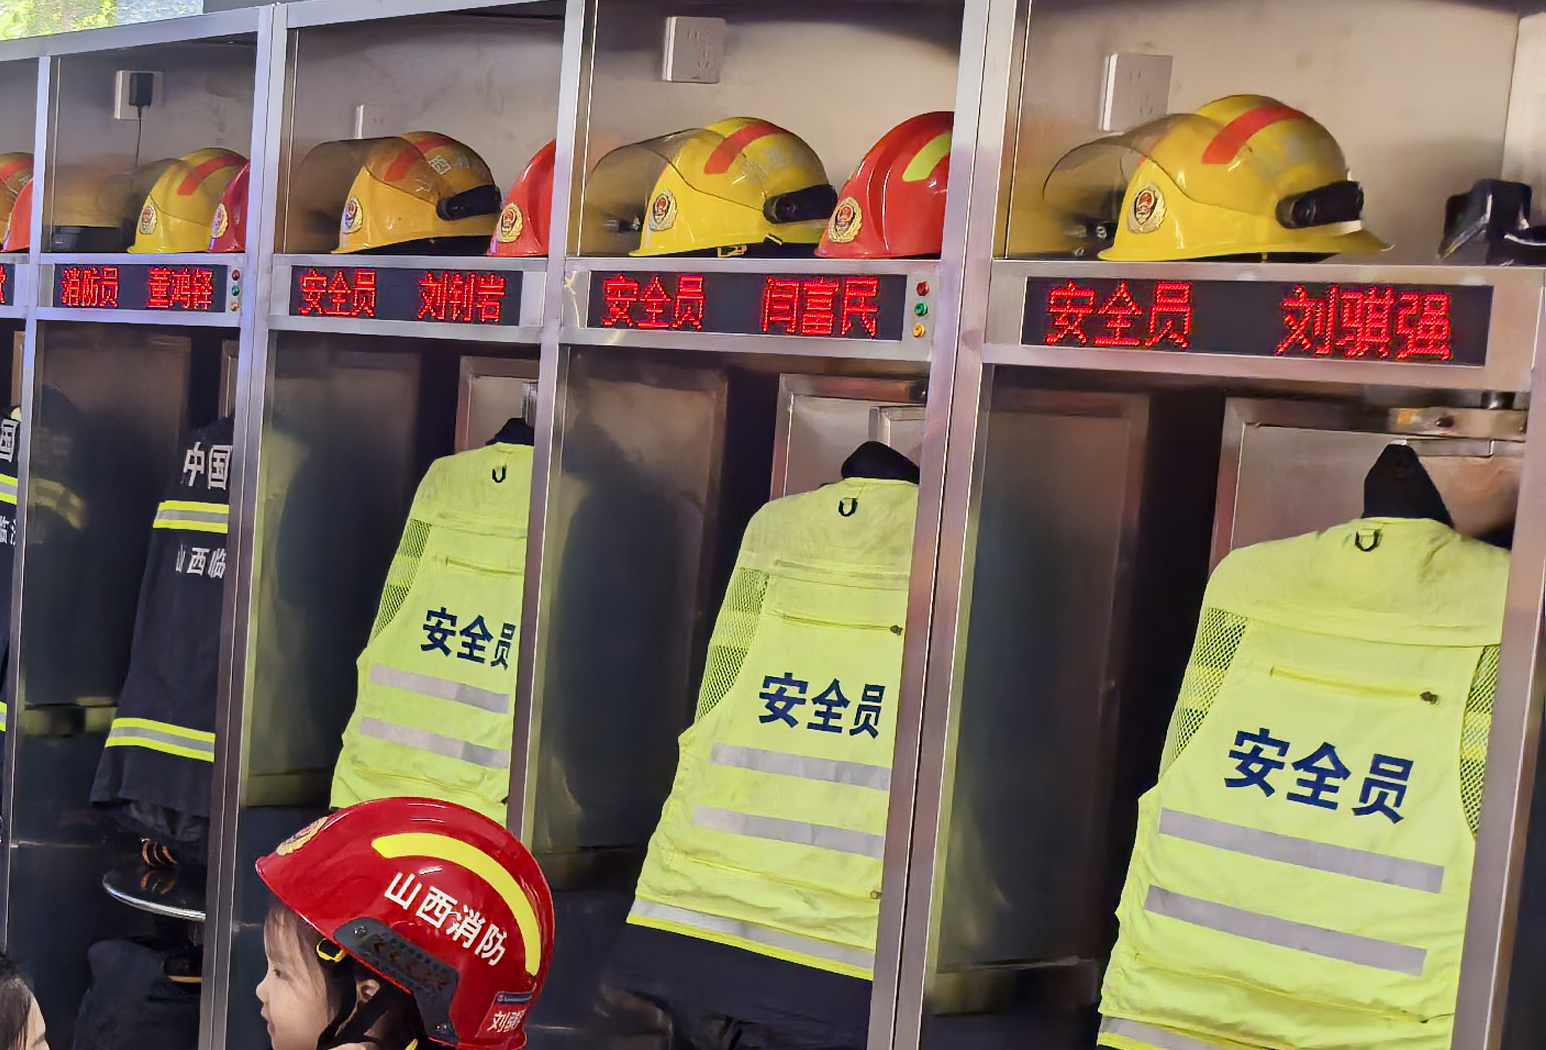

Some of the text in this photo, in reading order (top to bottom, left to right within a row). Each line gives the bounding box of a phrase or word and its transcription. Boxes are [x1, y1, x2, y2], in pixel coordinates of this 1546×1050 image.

[60, 267, 120, 309] 消防员
[299, 268, 377, 318] 安全员
[601, 274, 879, 339] 安全员 闫富民
[1046, 281, 1452, 362] 安全员 刘骐强
[182, 442, 233, 490] 中国
[421, 607, 517, 670] 安全员
[759, 672, 886, 739] 安全员
[1224, 728, 1414, 824] 安全员
[384, 871, 507, 966] 山西消防
